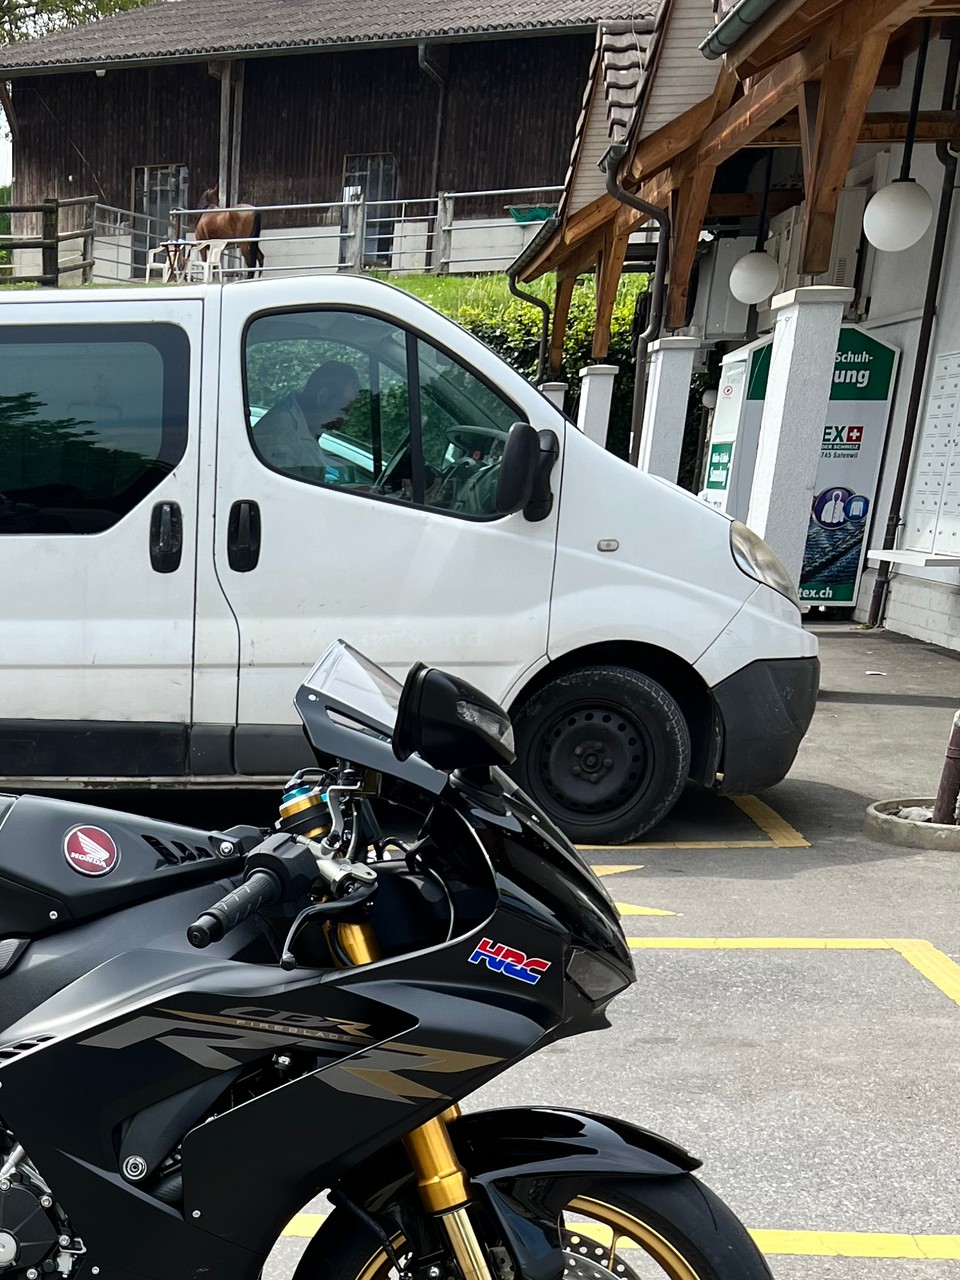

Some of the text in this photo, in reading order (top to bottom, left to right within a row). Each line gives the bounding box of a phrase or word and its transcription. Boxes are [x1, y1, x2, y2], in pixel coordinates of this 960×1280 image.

[70, 851, 108, 868] HONDA
[467, 936, 552, 986] HRC
[235, 1019, 353, 1042] FIREBLADE
